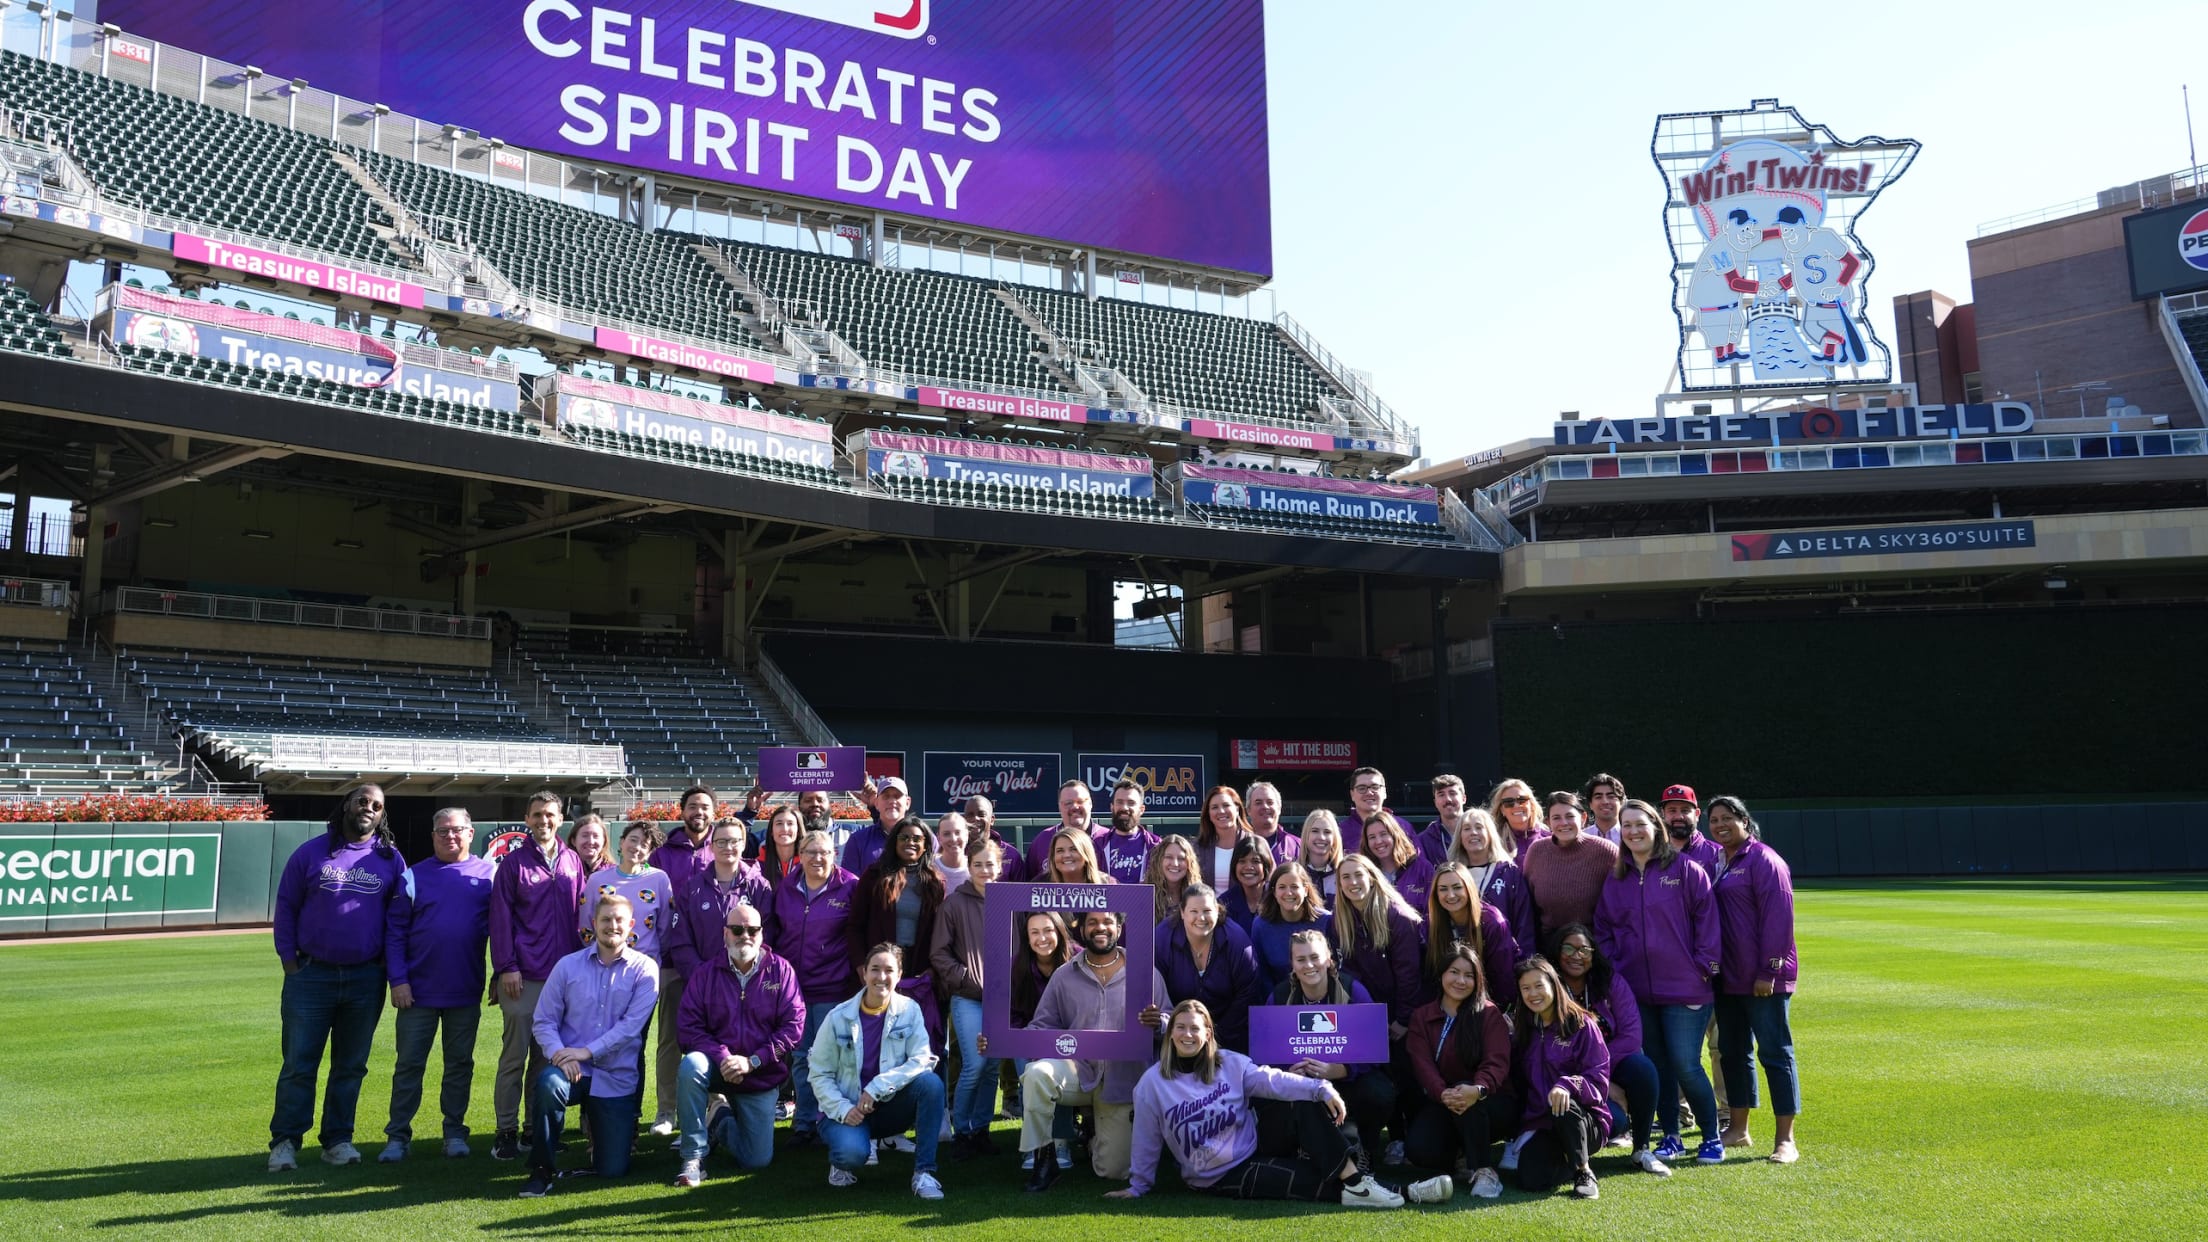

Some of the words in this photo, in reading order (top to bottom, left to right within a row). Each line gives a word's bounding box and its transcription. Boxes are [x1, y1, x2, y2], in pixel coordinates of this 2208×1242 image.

[119, 42, 146, 59] 331
[523, 0, 1001, 142] CELEBRATES
[558, 84, 809, 181] SPIRIT
[836, 134, 973, 211] DAY
[500, 153, 520, 167] 332
[1681, 159, 1758, 206] Win!
[1762, 148, 1875, 192] Twins!
[841, 226, 860, 237] 333
[203, 240, 320, 285] Treasure
[328, 267, 401, 302] Island
[1122, 272, 1139, 283] 334
[627, 335, 748, 379] TIcasino.com
[221, 336, 382, 387] Treasure
[394, 374, 491, 408] sland
[936, 389, 1015, 416] Treasure
[1020, 401, 1071, 421] Island
[1555, 411, 1791, 445] TARGET
[1857, 401, 2035, 438] FIELD
[626, 410, 703, 445] Home
[711, 427, 758, 456] Run
[767, 436, 825, 468] Deck
[1215, 422, 1313, 449] TIcasino.com
[1463, 448, 1503, 467] CUTWATER
[944, 461, 1053, 489] Treasure
[1061, 472, 1131, 497] Island
[1260, 490, 1321, 515] Home
[1326, 497, 1364, 520] Run
[1372, 500, 1418, 523] Deck
[1799, 536, 1872, 551] DELTA
[1283, 743, 1300, 757] HIT
[1302, 743, 1321, 757] THE
[1323, 743, 1351, 757] BUDS
[962, 760, 992, 768] YOUR
[993, 760, 1025, 768] VOICE
[788, 770, 835, 779] CELEBRATES
[791, 778, 815, 786] SPIRIT
[943, 774, 992, 804] Your
[995, 767, 1043, 793] Vote!
[1144, 793, 1197, 806] olar.com
[1031, 887, 1064, 896] STAND
[1065, 887, 1107, 897] AGAINST
[1031, 895, 1108, 909] BULLYING
[1055, 1038, 1075, 1048] Spirit
[1288, 1036, 1348, 1045] CELEBRATES
[1063, 1045, 1077, 1055] Day
[1292, 1046, 1323, 1055] SPIRIT
[1324, 1046, 1344, 1054] DAY
[1165, 1082, 1231, 1131] Minnesota
[1174, 1104, 1237, 1159] Twins
